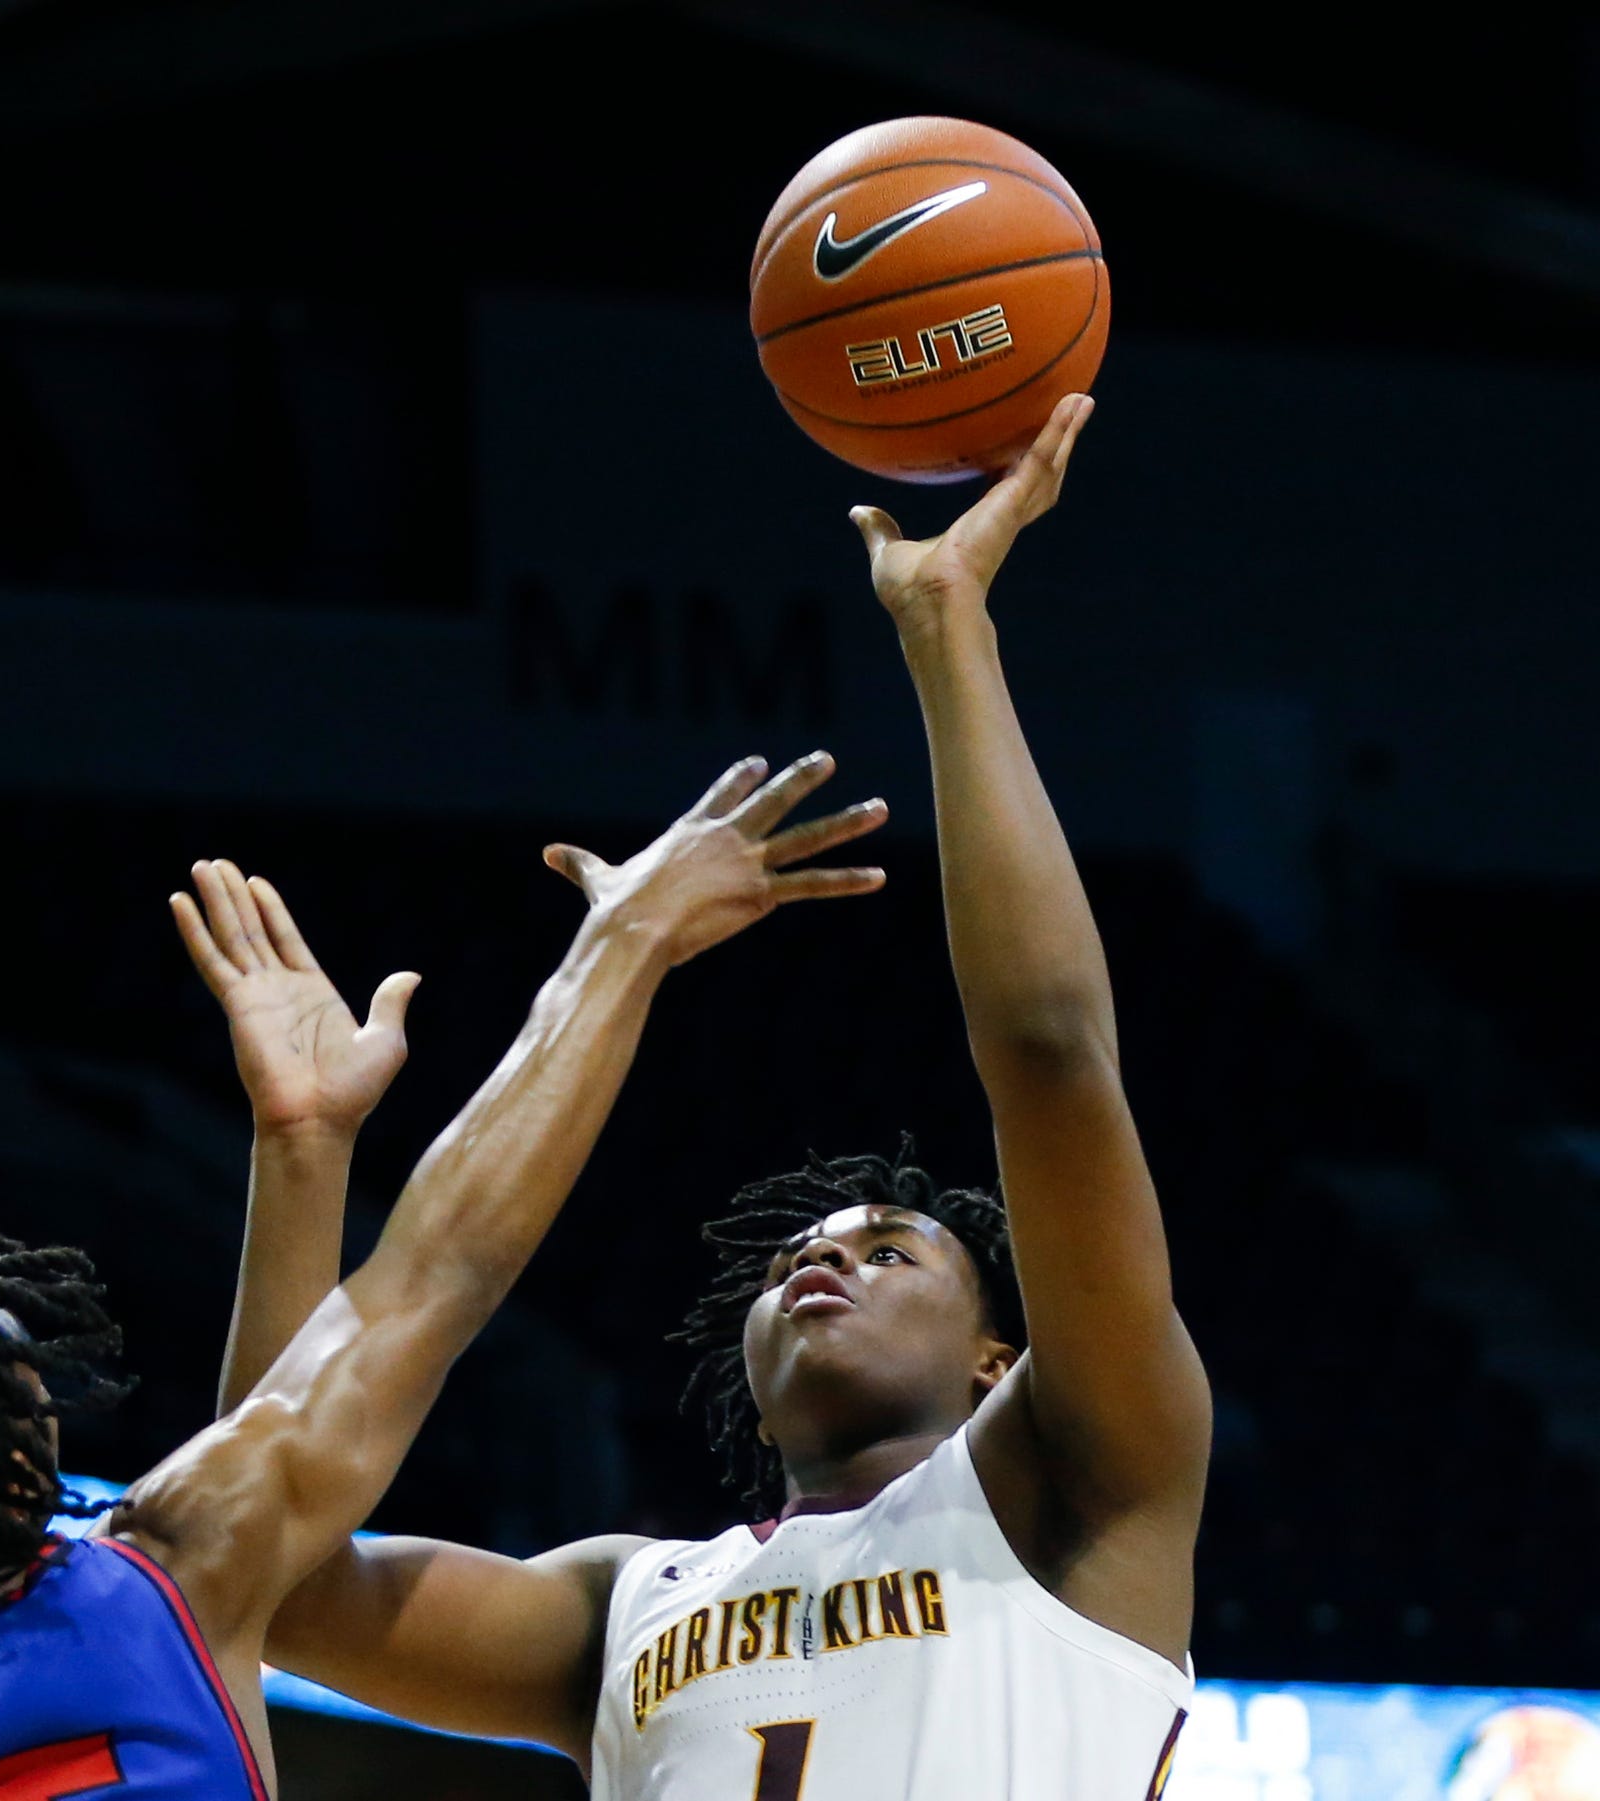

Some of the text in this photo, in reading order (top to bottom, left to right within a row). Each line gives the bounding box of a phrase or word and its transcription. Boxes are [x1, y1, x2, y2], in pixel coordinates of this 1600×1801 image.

[846, 304, 1012, 386] ELITE
[633, 1586, 799, 1733] CHRIST
[820, 1569, 950, 1653] KING
